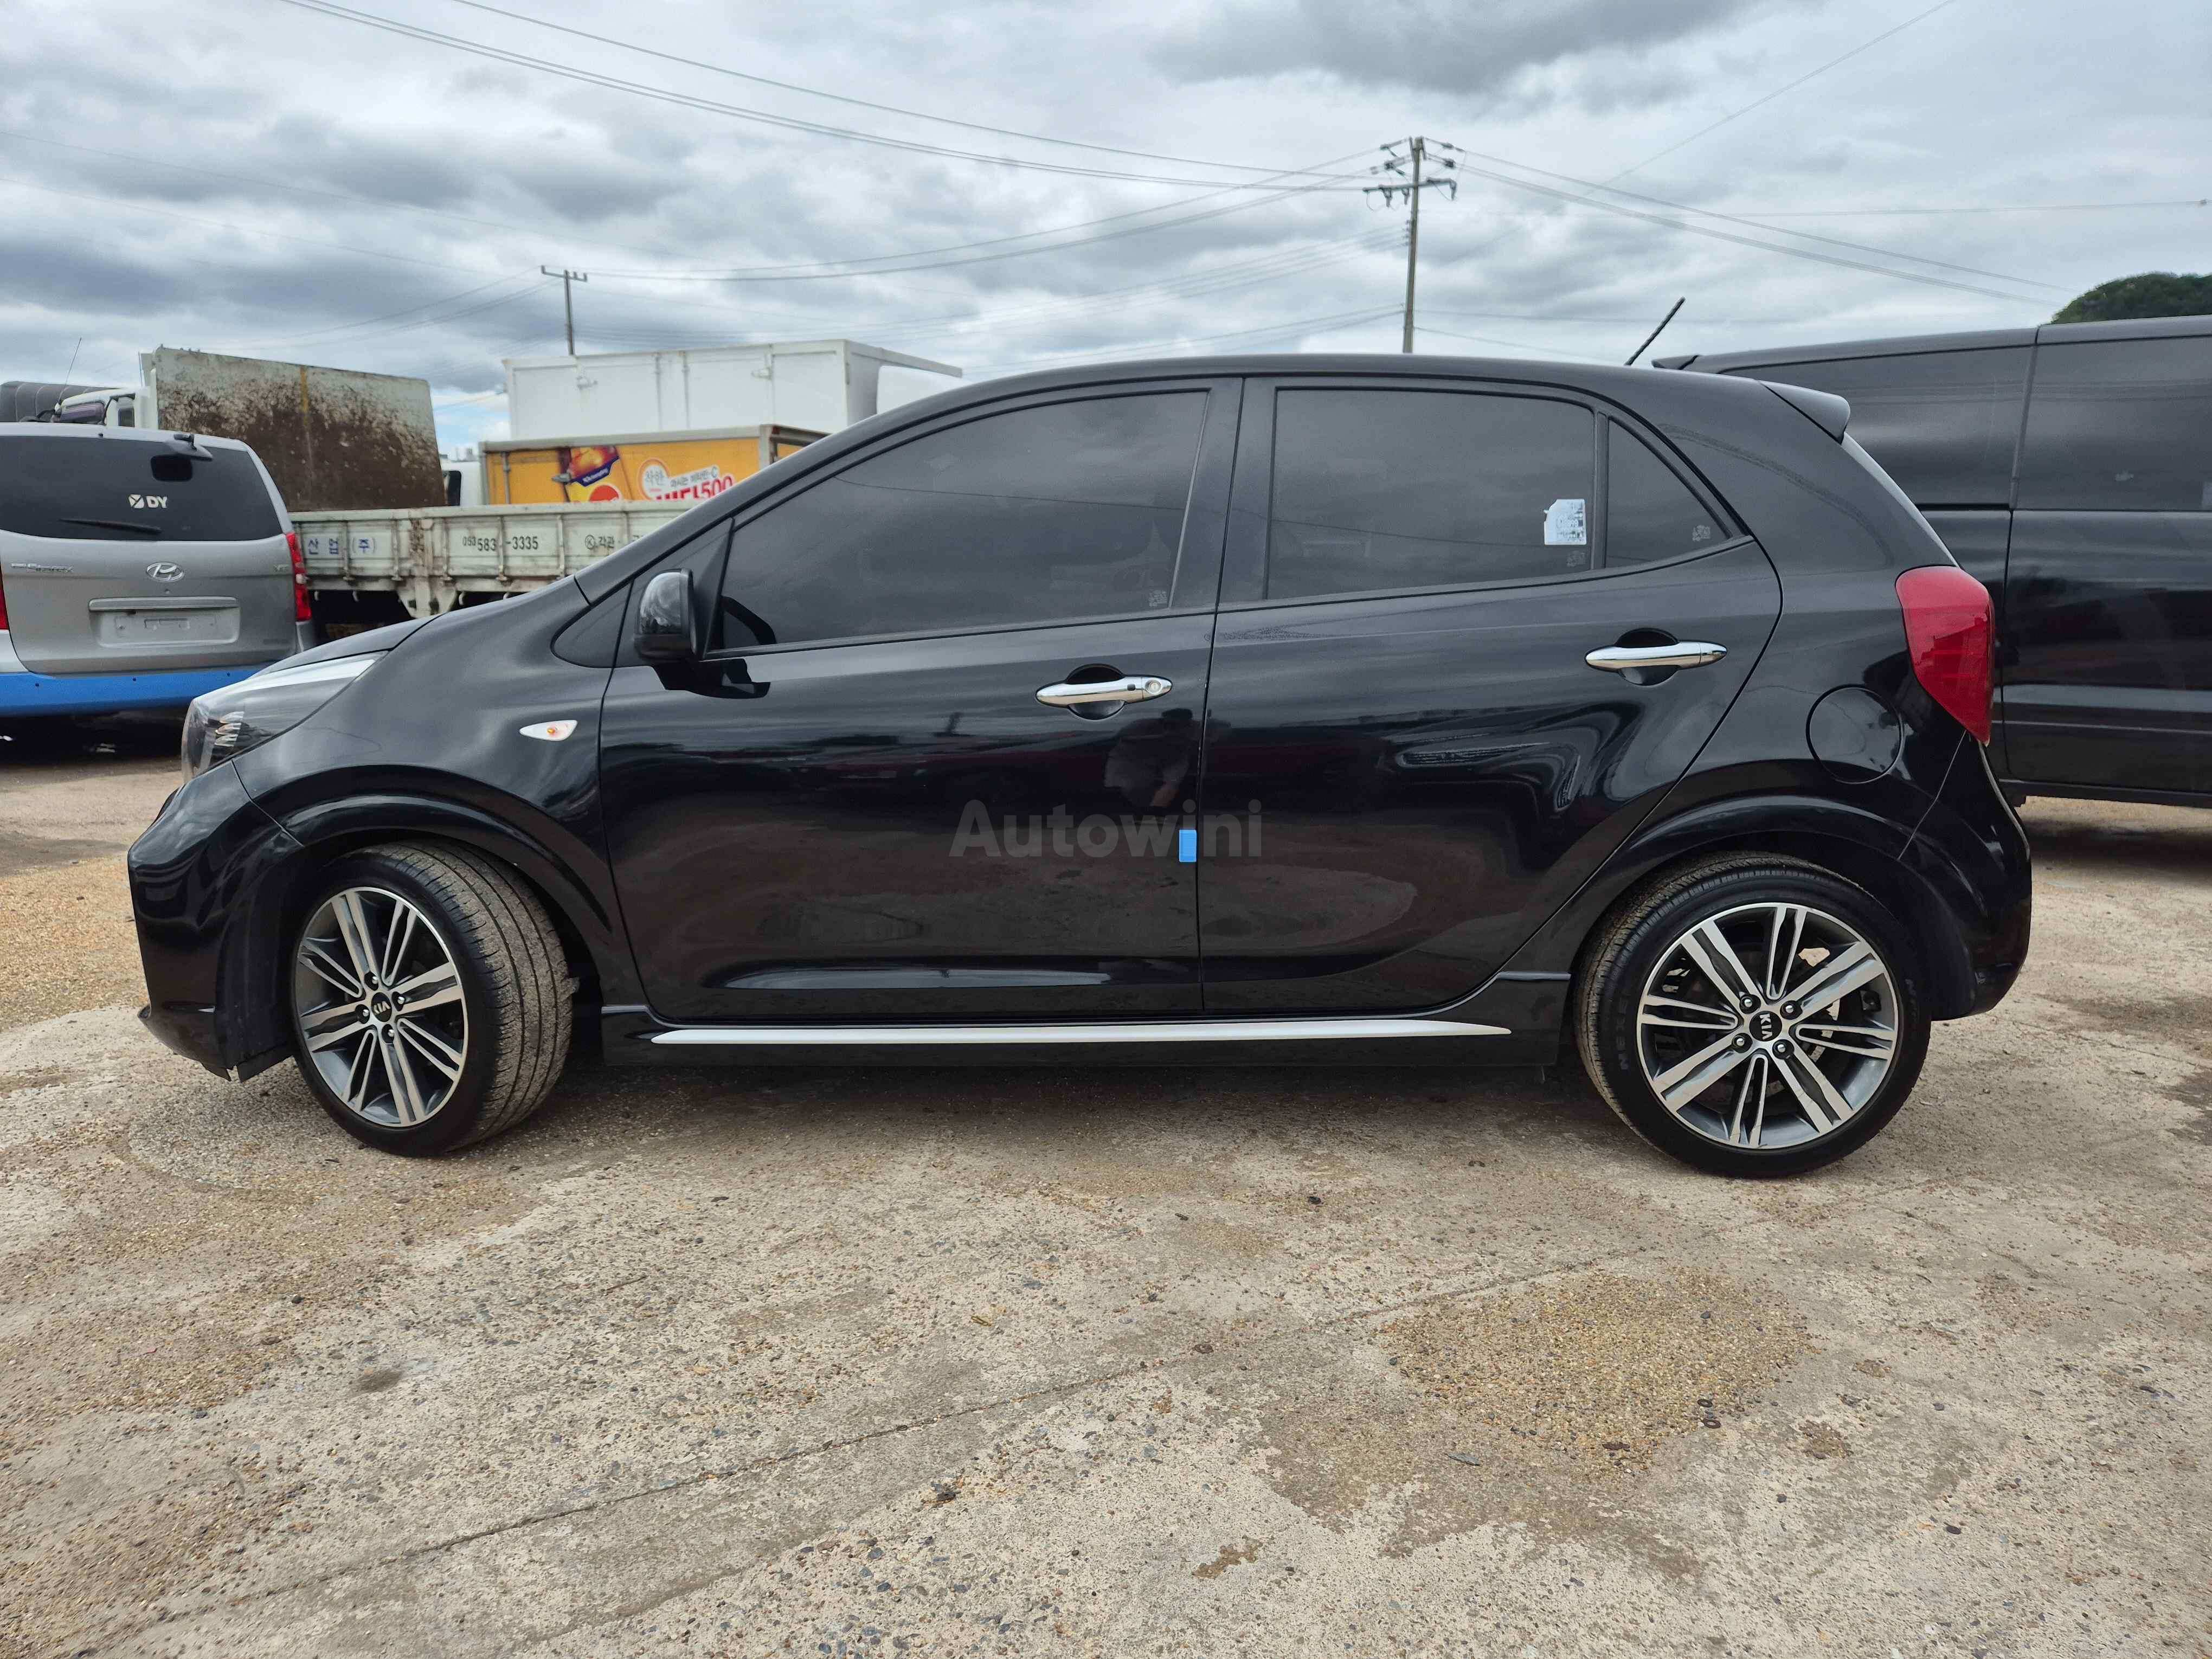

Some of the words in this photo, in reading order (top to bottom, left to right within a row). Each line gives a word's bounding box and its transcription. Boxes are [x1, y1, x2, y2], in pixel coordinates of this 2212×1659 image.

[146, 496, 168, 509] DY
[478, 538, 496, 551] 583
[1759, 1013, 1773, 1040] KIA
